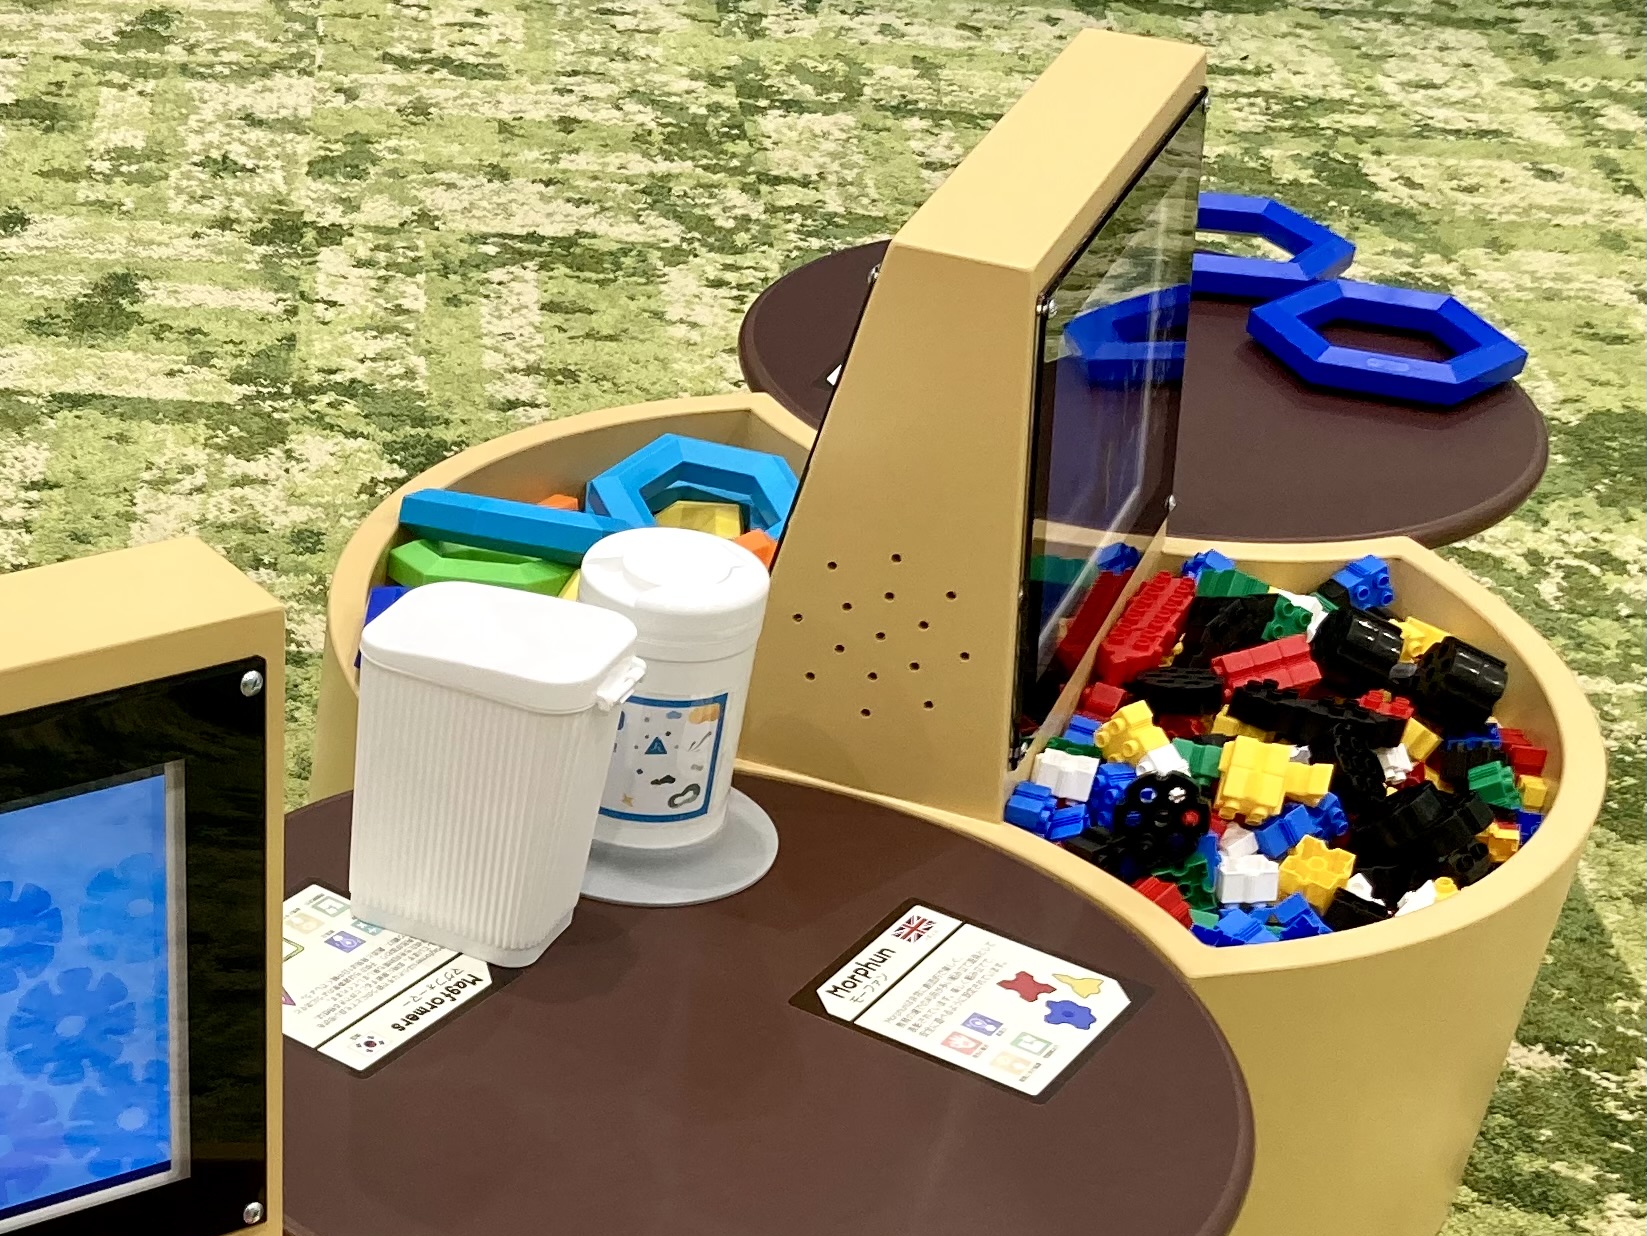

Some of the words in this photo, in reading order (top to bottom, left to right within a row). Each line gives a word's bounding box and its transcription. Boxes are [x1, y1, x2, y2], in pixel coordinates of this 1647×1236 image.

[402, 968, 465, 1007] マグフォーマー
[826, 948, 896, 999] Morphun
[849, 973, 887, 1003] モーファン
[390, 972, 484, 1033] Magformers
